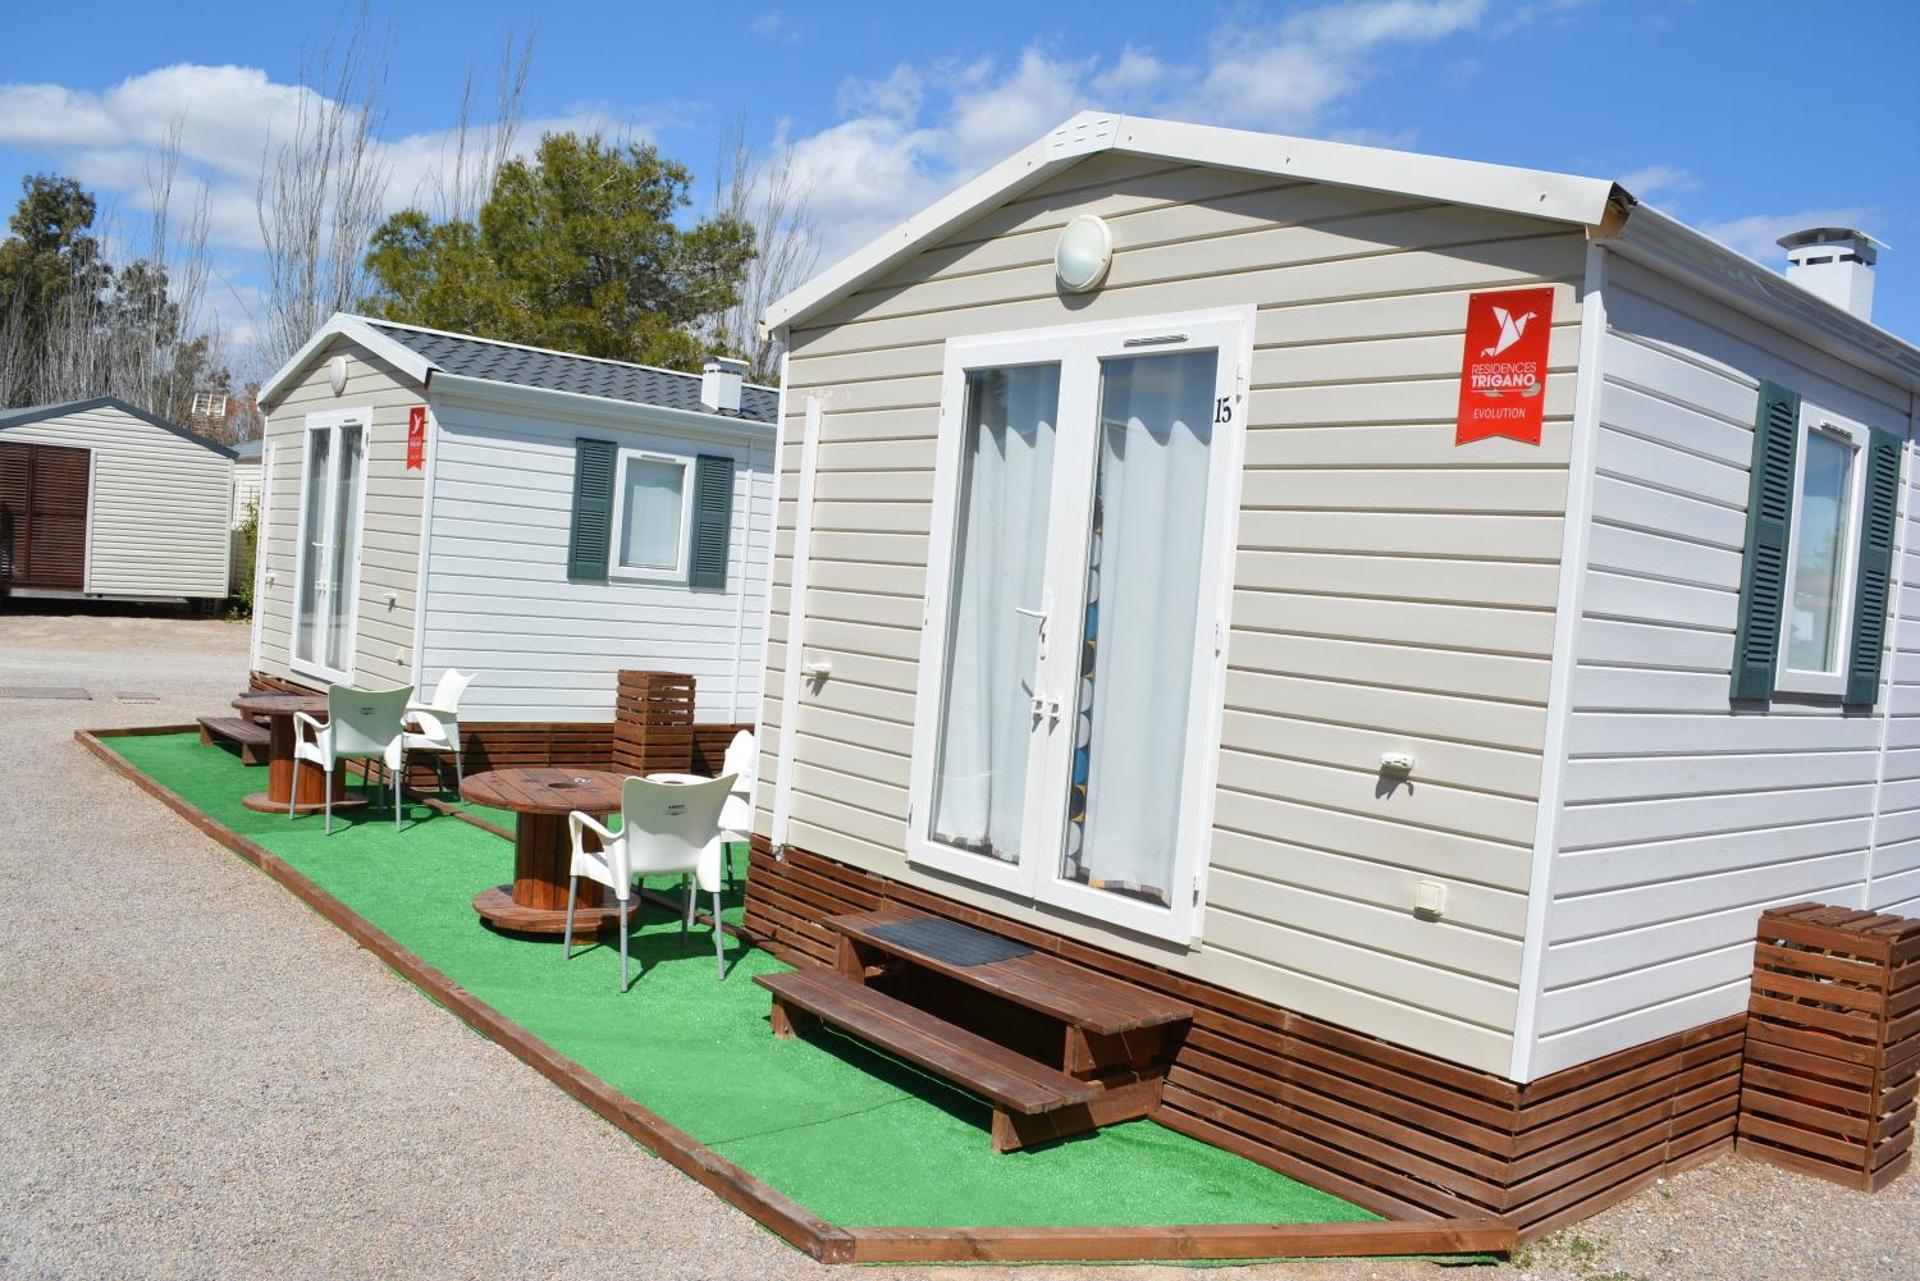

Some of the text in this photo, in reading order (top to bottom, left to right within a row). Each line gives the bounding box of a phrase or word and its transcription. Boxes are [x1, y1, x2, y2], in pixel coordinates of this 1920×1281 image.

[1472, 361, 1537, 375] RESIDENCES
[1471, 373, 1536, 388] TRIGANO
[1214, 396, 1232, 423] 15
[1473, 407, 1526, 419] EVOLUTION
